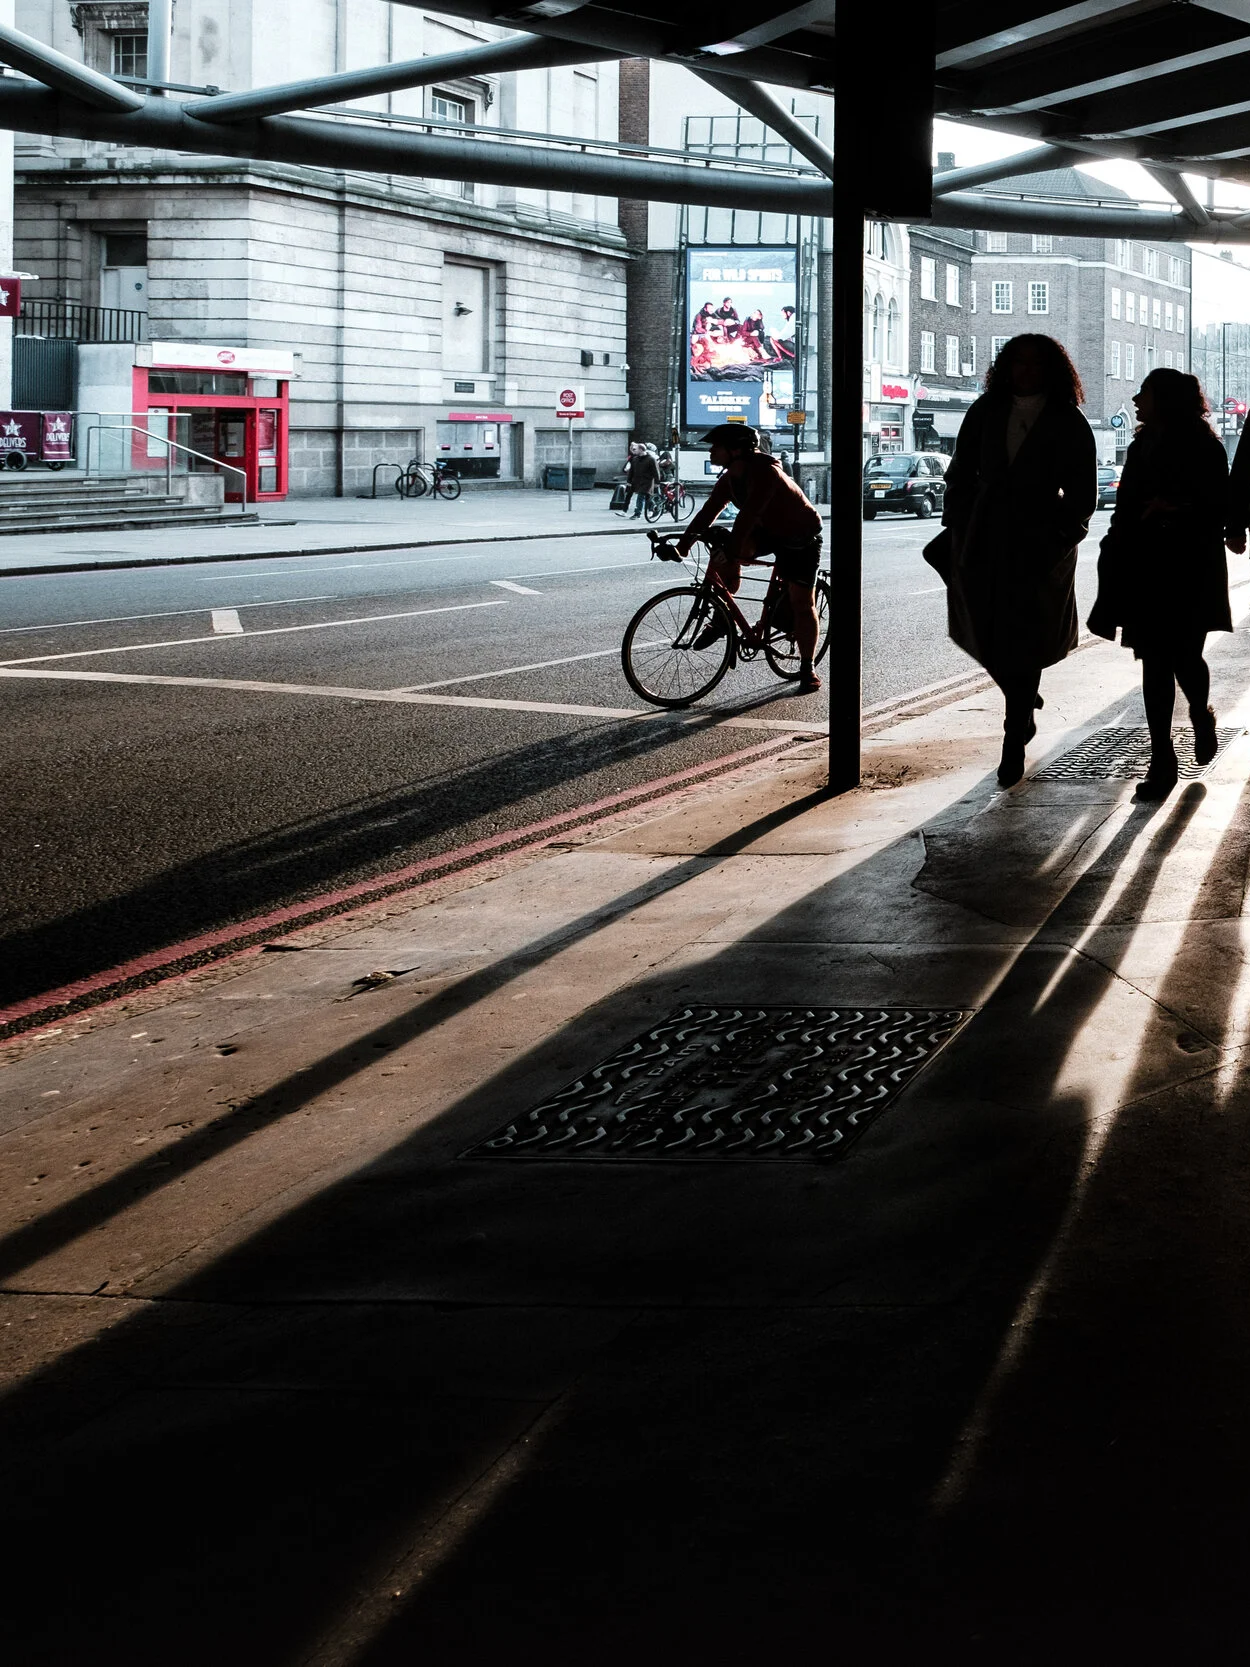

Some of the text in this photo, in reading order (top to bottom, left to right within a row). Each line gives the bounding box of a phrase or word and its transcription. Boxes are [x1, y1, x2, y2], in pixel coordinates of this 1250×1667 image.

[703, 268, 783, 281] FOR WILD SPIRITS
[46, 432, 70, 442] DELIVERS
